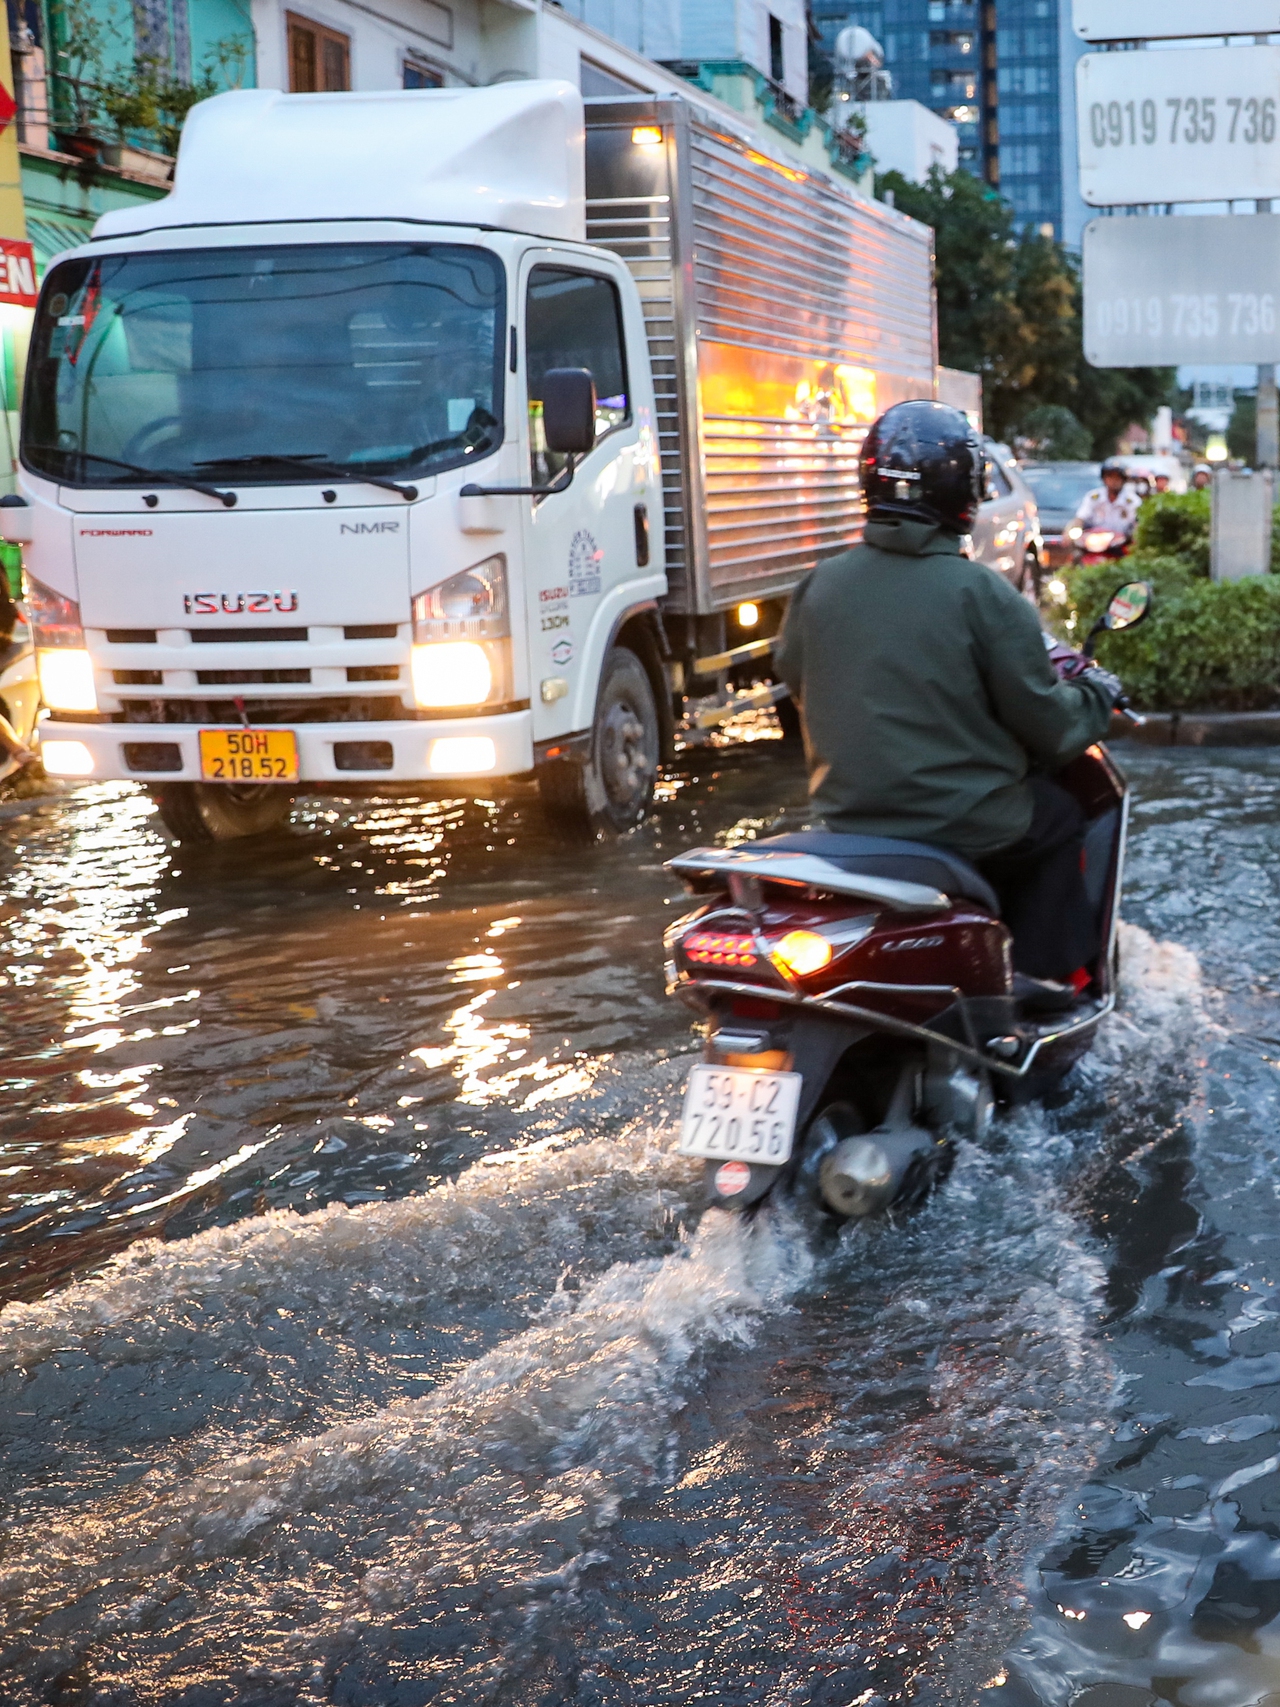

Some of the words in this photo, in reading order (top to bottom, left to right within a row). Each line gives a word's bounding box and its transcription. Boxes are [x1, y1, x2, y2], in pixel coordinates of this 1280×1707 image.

[1090, 99, 1157, 148] 0919
[1166, 98, 1216, 144] 735
[1226, 98, 1276, 144] 736
[1097, 297, 1162, 337] 0919
[1170, 294, 1219, 337] 735
[1228, 293, 1275, 335] 736
[340, 521, 399, 534] NMR
[183, 589, 298, 614] ISUZU
[227, 734, 269, 754] 50H
[212, 758, 288, 779] 218.52
